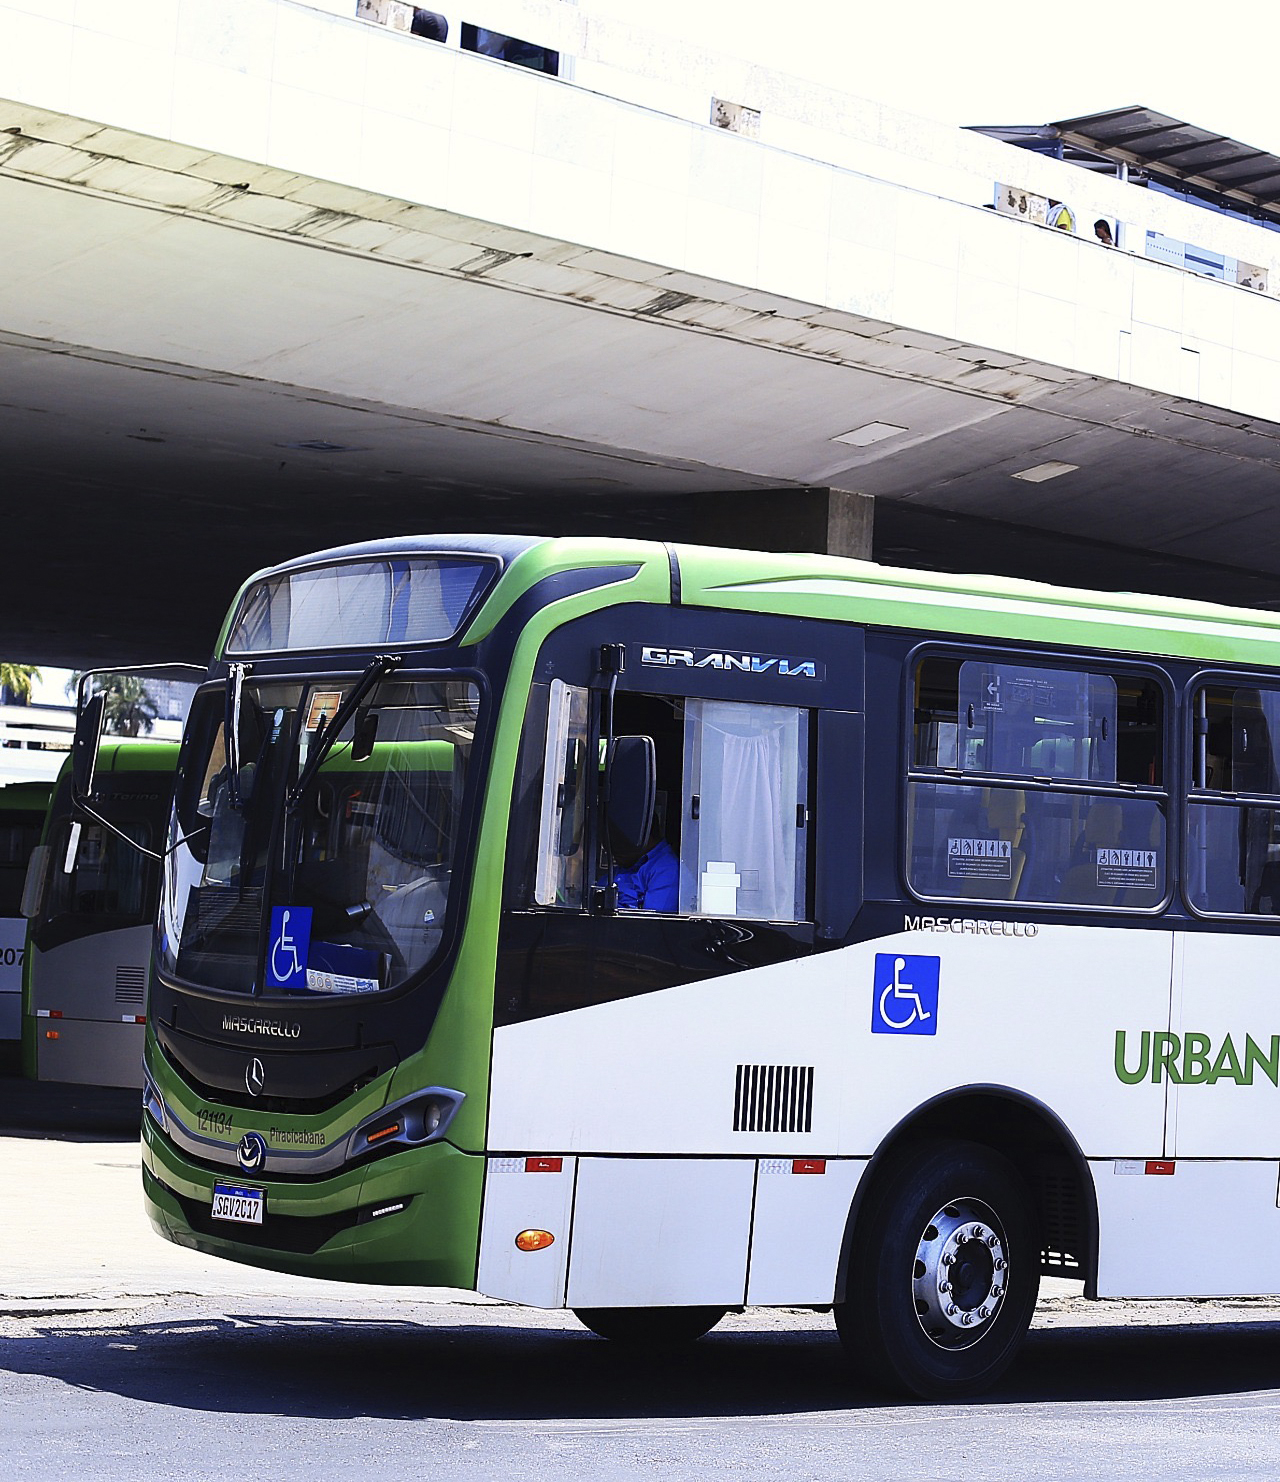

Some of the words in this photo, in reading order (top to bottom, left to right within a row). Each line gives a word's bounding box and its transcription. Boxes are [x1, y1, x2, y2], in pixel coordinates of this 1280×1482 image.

[641, 646, 816, 678] GRANVIA
[904, 914, 1039, 938] MASCARELLO
[0, 948, 25, 966] 07
[222, 1014, 301, 1038] MASCARELLO
[196, 1109, 234, 1135] 121134
[269, 1127, 326, 1145] Piracicabana
[216, 1196, 259, 1220] SGV2C17
